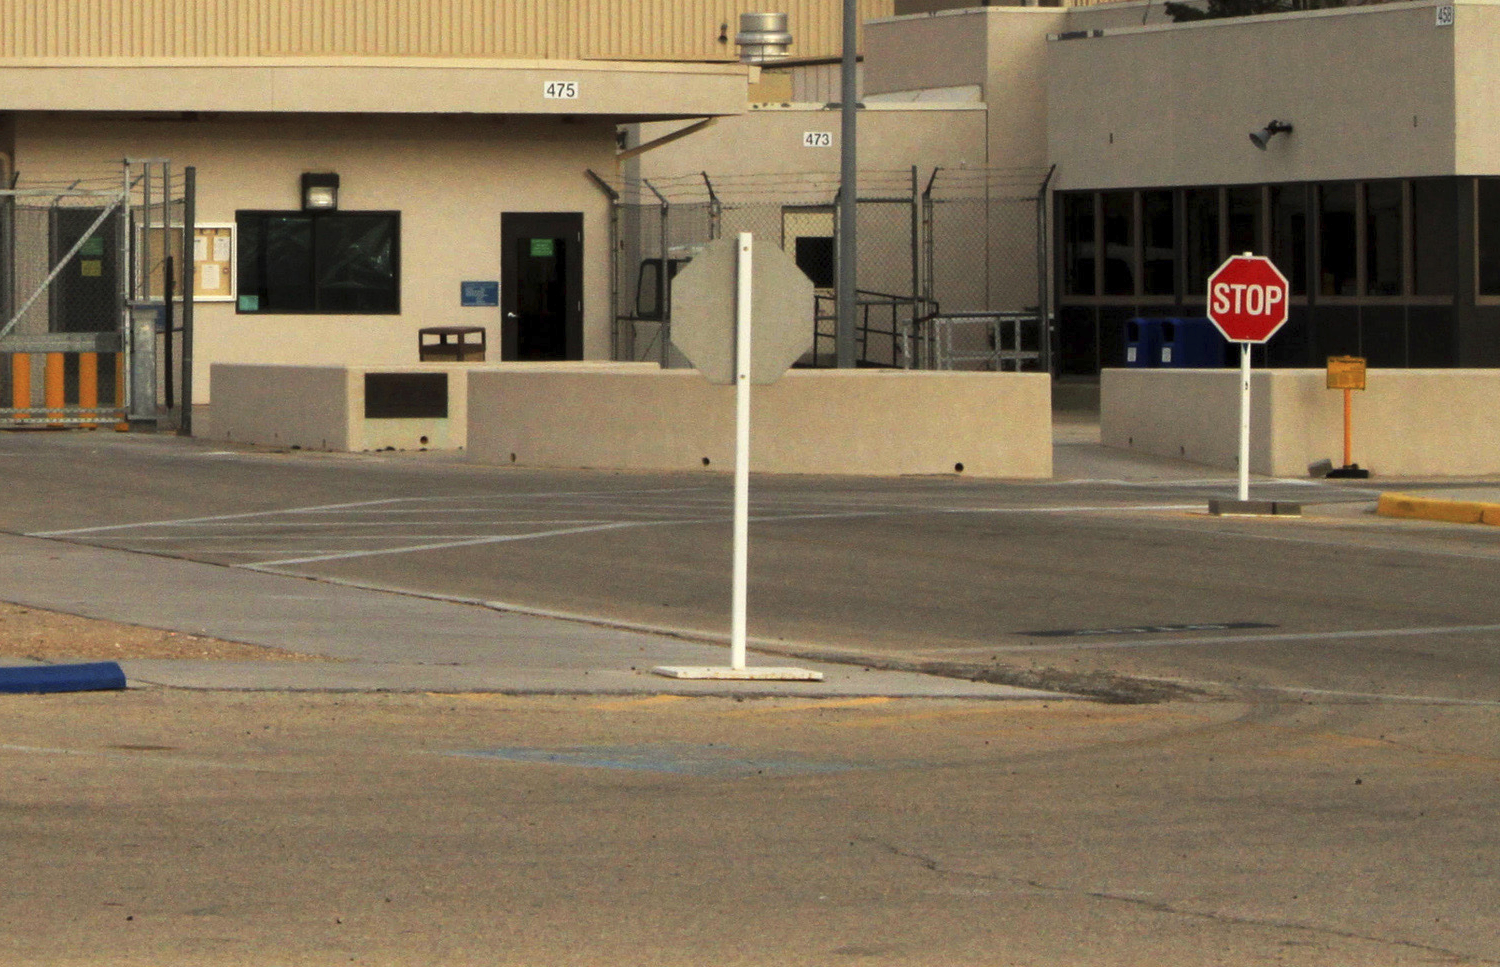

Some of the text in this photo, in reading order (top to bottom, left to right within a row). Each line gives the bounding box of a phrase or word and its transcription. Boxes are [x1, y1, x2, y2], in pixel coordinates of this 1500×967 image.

[546, 83, 575, 98] 475
[805, 133, 830, 146] 473
[1212, 282, 1283, 316] STOP
